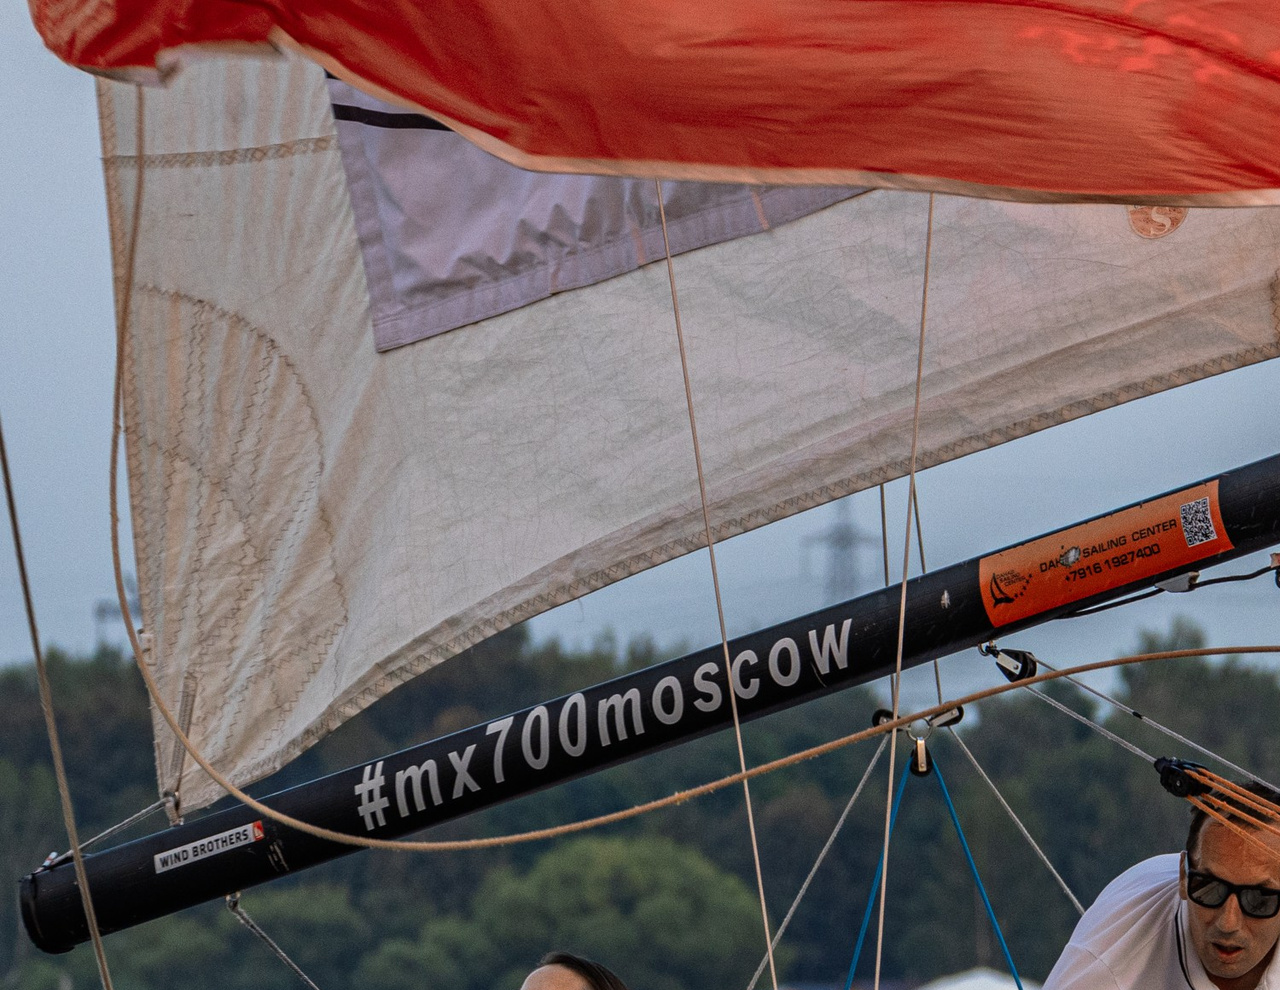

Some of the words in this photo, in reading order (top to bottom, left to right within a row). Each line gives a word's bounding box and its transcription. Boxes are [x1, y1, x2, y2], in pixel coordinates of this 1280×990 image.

[1083, 535, 1127, 558] SAILING
[1131, 519, 1177, 541] CENTER
[1104, 543, 1161, 570] 1927400
[354, 618, 853, 831] #mx700moscow
[159, 849, 189, 868] WIND
[193, 829, 249, 857] BROTHERS
